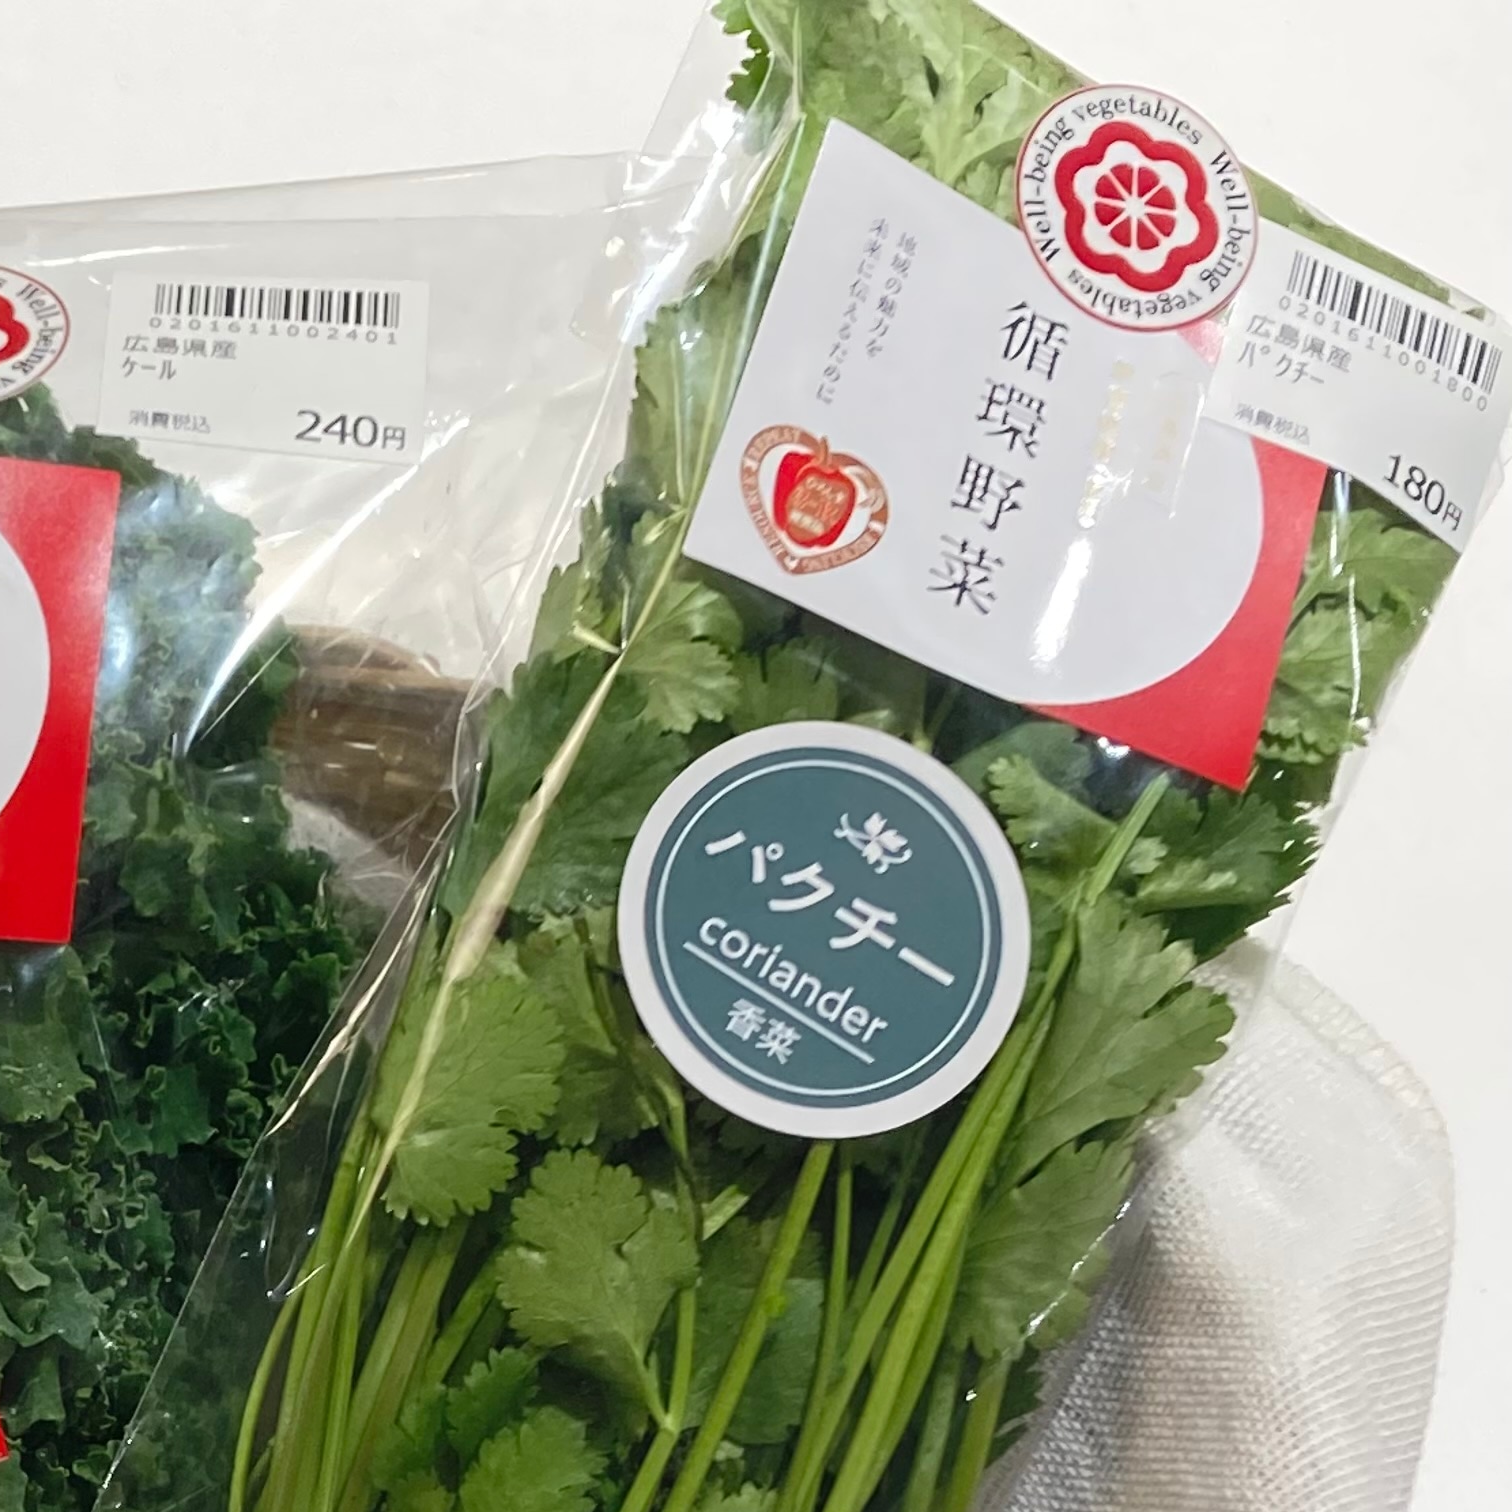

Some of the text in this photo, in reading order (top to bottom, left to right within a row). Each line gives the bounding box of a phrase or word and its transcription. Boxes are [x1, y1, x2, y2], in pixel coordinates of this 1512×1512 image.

[1023, 93, 1204, 263] Well-being vegetables
[1067, 149, 1251, 320] Well-being vegetables
[12, 283, 63, 376] Well-being
[122, 334, 237, 360] 広島県産
[122, 356, 176, 380] ケール
[149, 317, 397, 346] 0201611002401
[1246, 314, 1353, 374] 広島県産
[1278, 295, 1488, 412] 0201611001800
[129, 409, 211, 434] 消費税込
[295, 409, 406, 451] 240円
[926, 299, 1070, 616] 循環野菜
[1383, 453, 1464, 532] 180円
[705, 829, 955, 987] パクチー
[697, 915, 889, 1044] coriander
[725, 998, 802, 1065] 香菜
